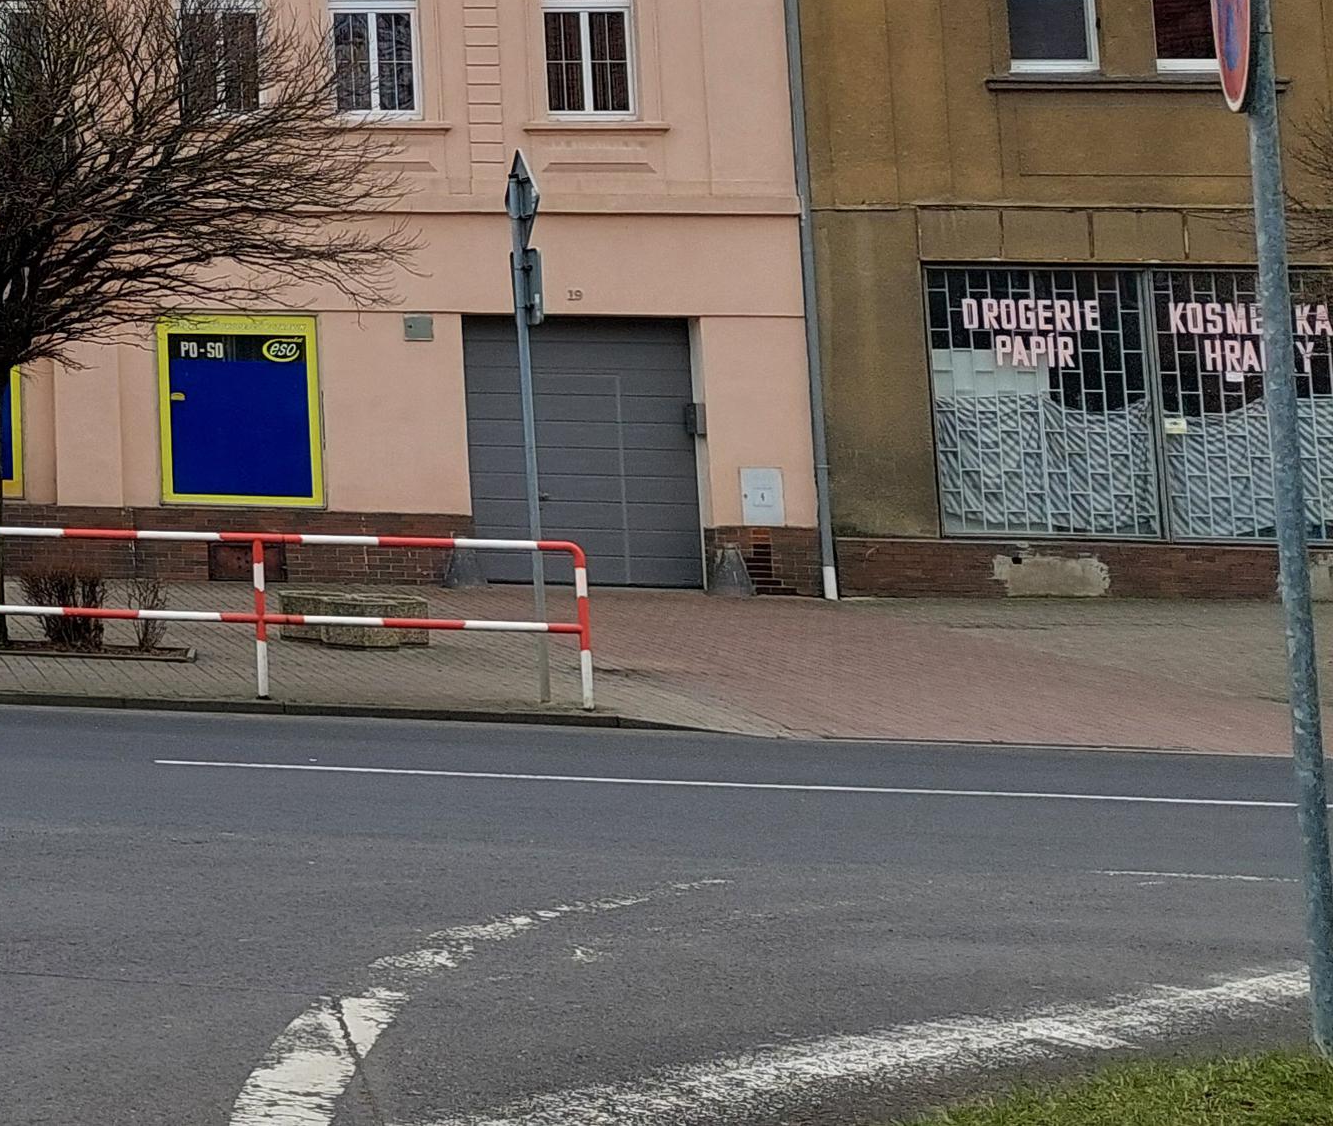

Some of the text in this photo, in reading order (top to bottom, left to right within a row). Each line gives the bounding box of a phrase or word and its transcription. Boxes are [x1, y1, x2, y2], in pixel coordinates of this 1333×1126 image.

[567, 289, 583, 301] 19
[961, 298, 1101, 331] DROGERIE
[1168, 302, 1333, 336] KOSMEKA
[269, 343, 297, 357] eso
[995, 333, 1076, 368] PAPÍR
[1203, 339, 1314, 373] HRAY
